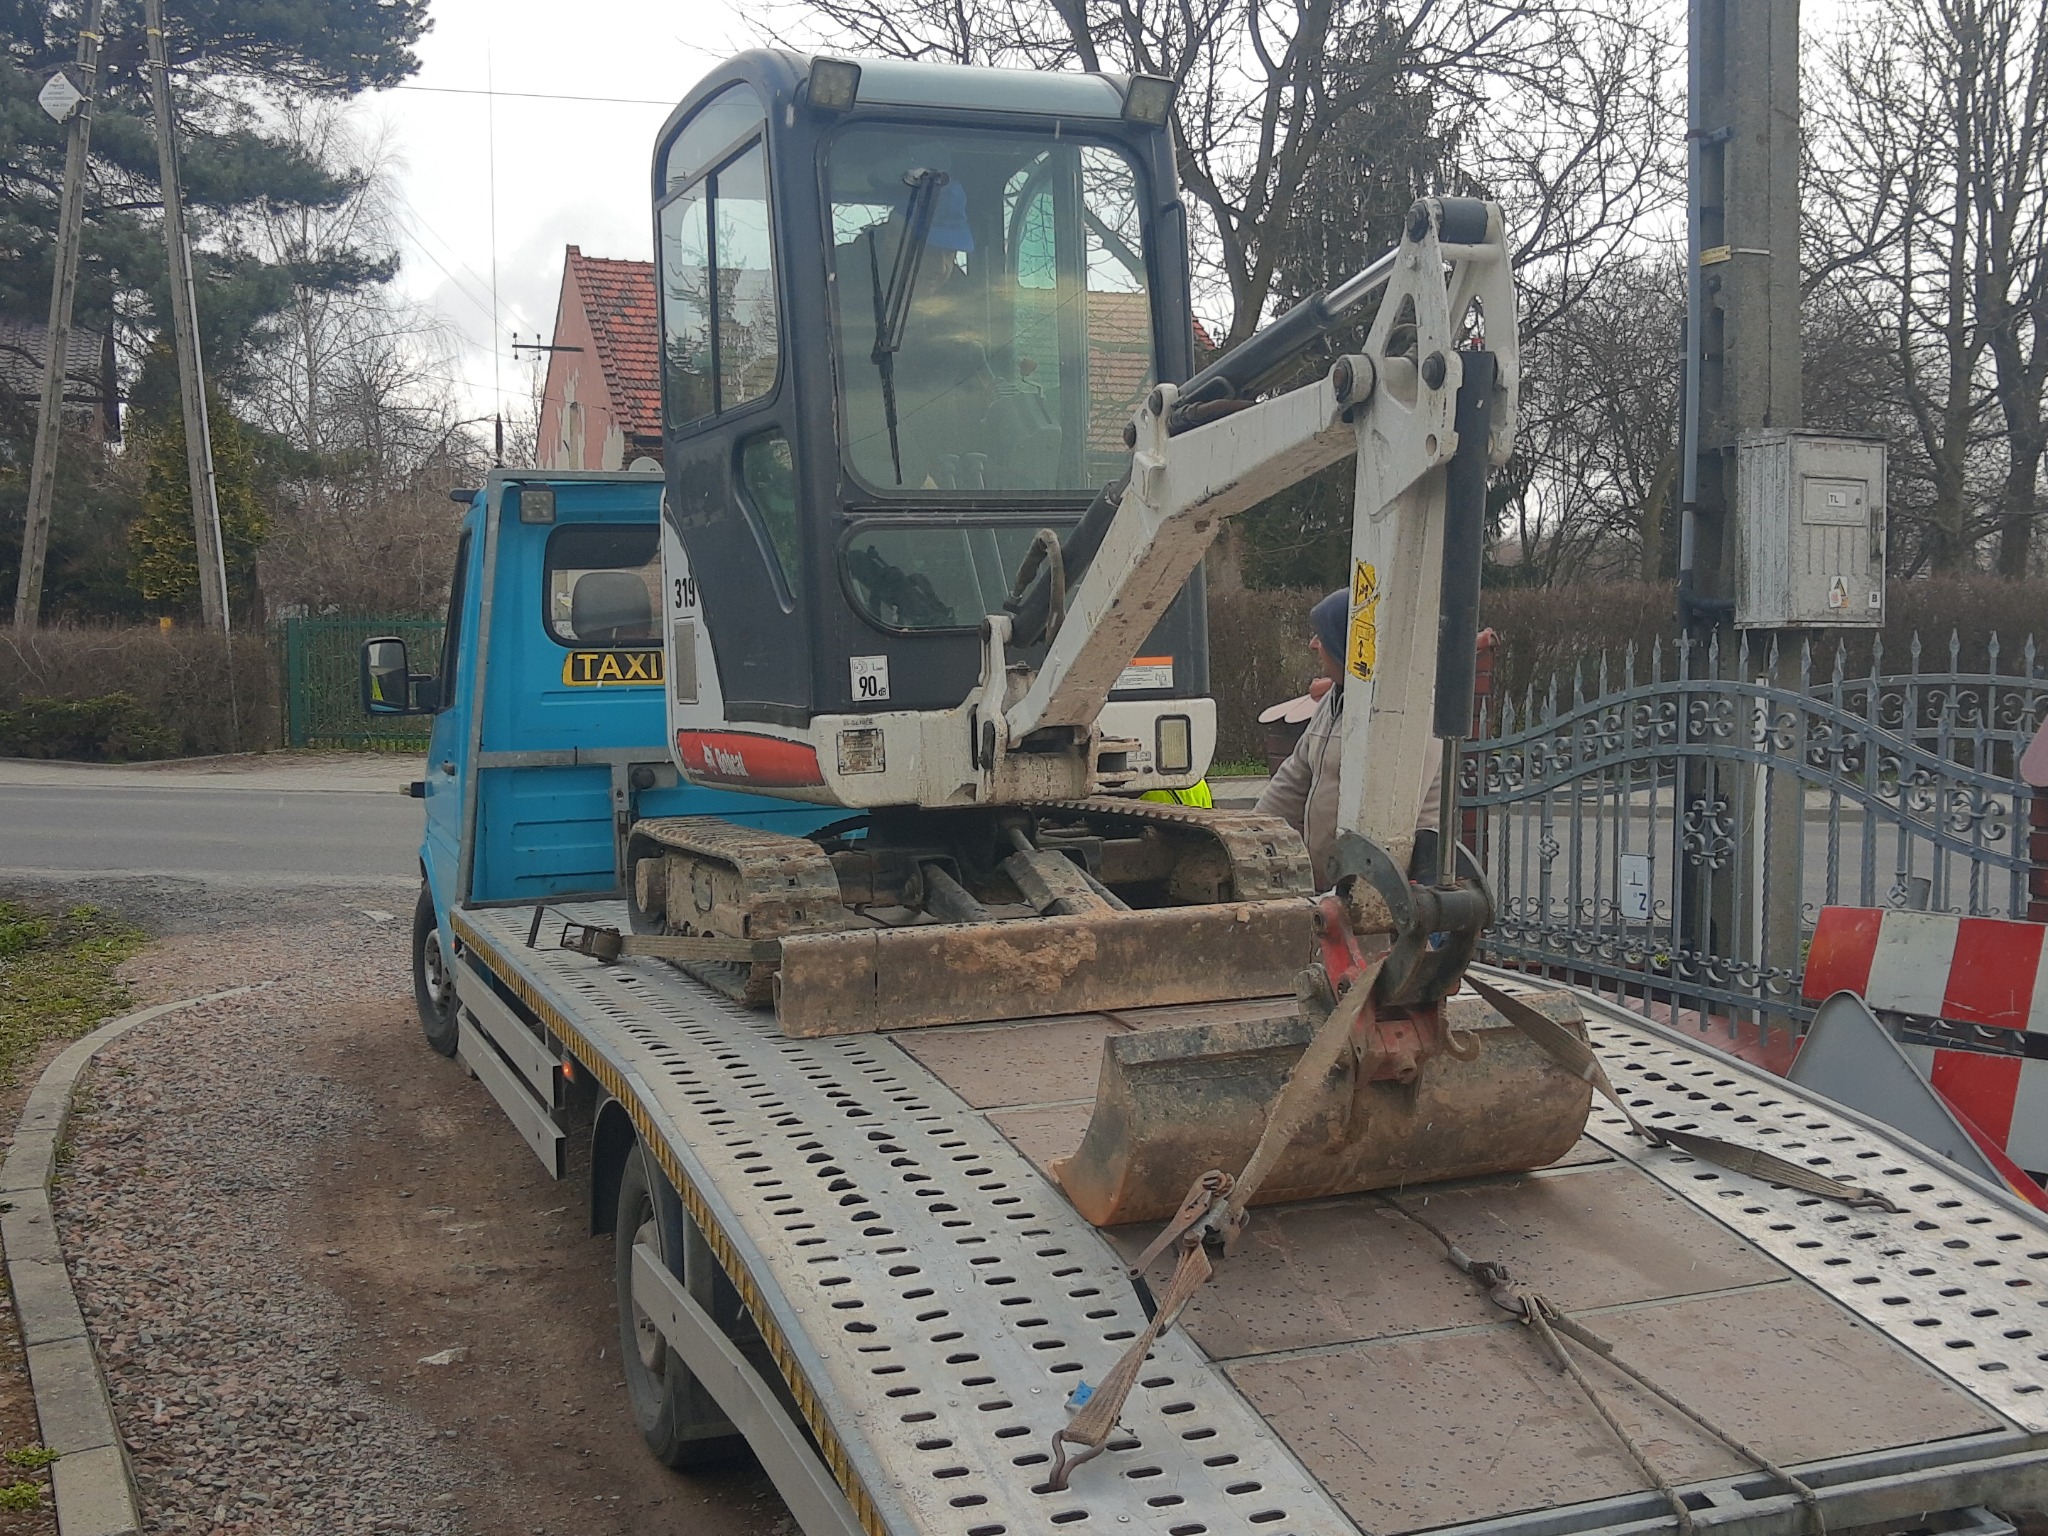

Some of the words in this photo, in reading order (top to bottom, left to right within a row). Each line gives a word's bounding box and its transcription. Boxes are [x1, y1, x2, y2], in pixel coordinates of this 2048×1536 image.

[674, 577, 696, 609] 319
[577, 653, 659, 680] TAXI
[859, 675, 878, 697] 90
